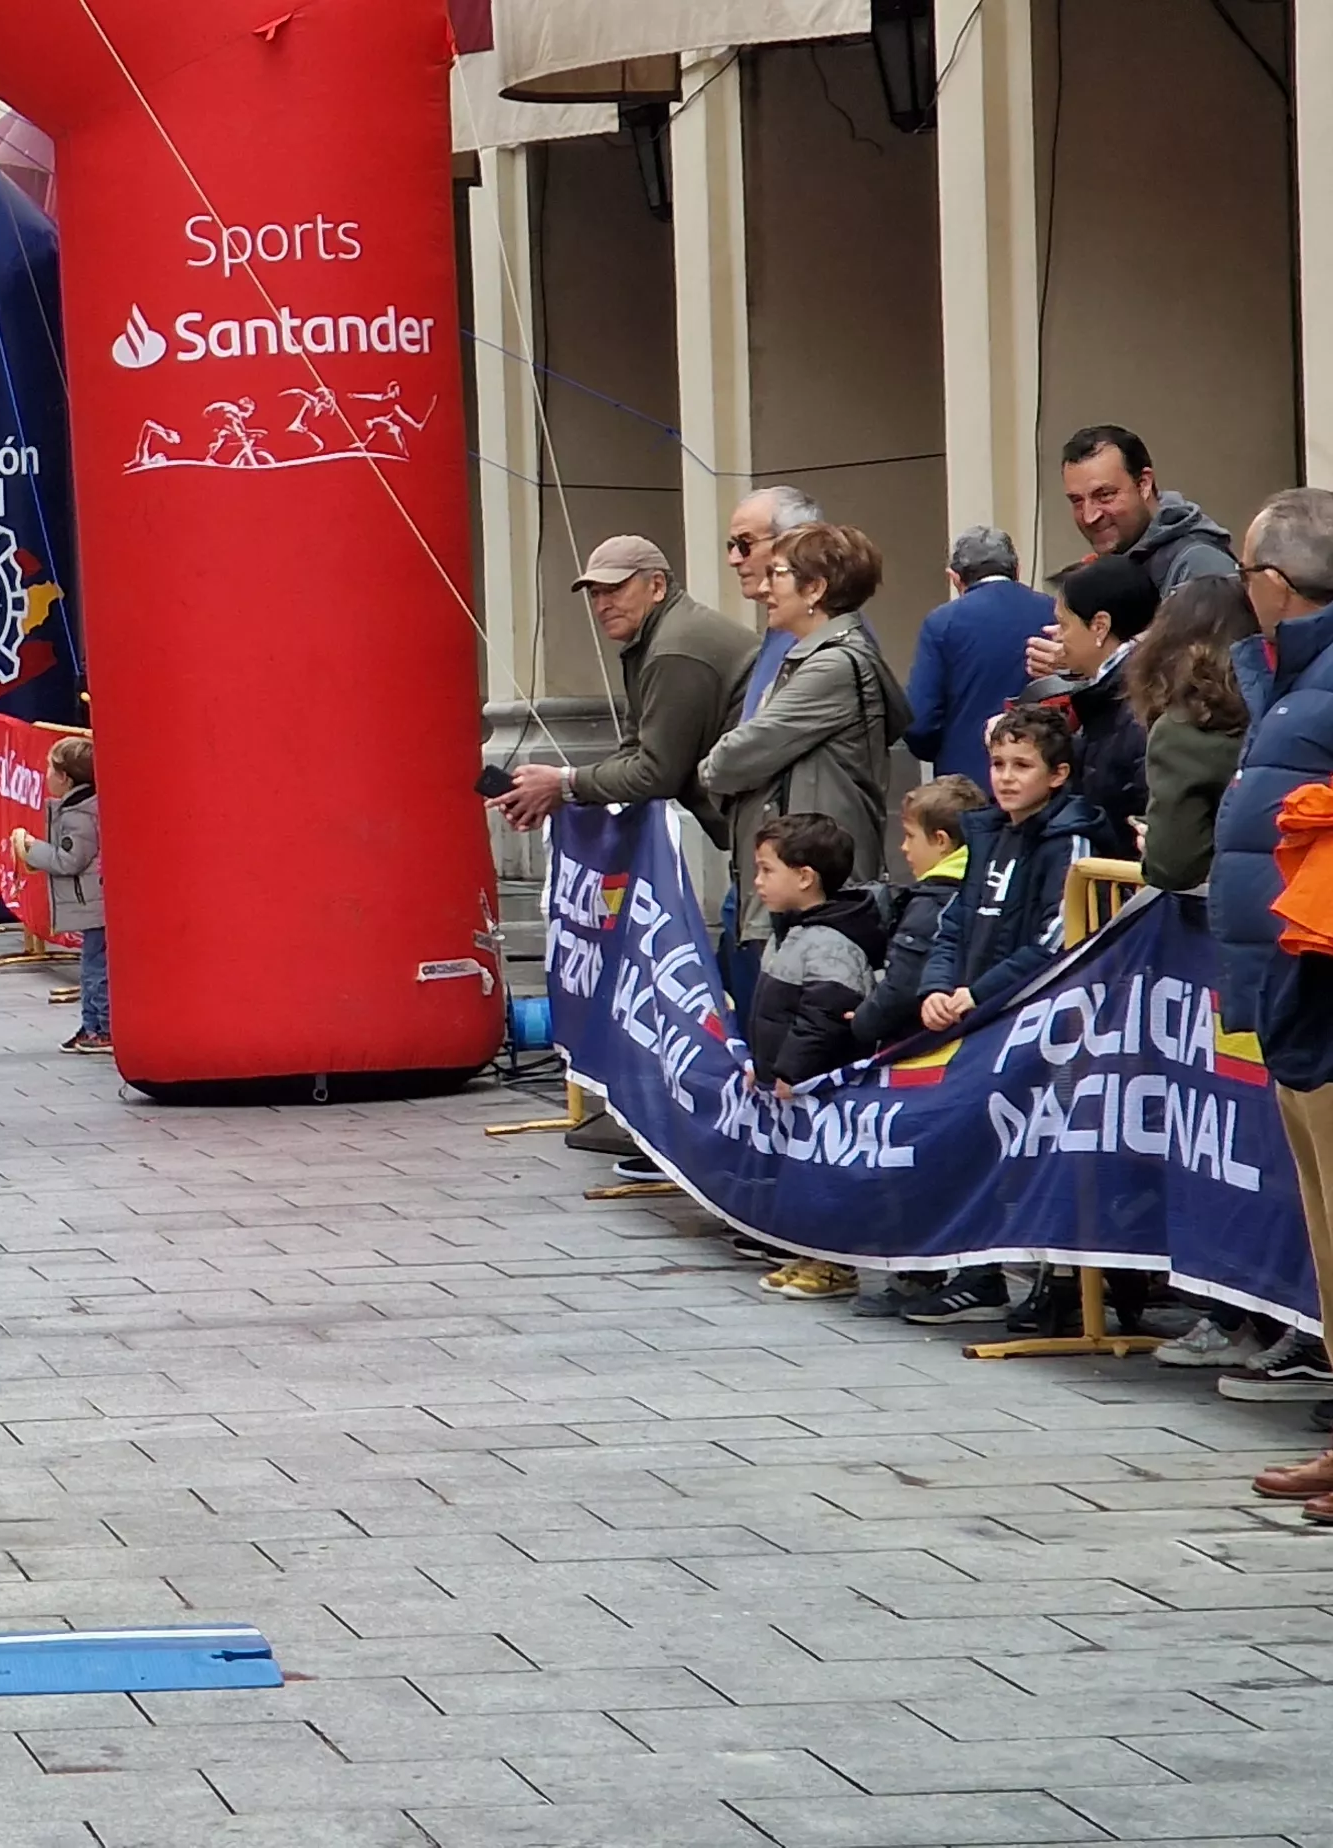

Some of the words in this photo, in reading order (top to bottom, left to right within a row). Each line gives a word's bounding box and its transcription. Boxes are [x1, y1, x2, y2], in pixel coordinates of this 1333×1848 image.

[185, 213, 362, 278] Sports
[176, 304, 435, 362] Santander
[988, 1072, 1262, 1193] NACIONAL
